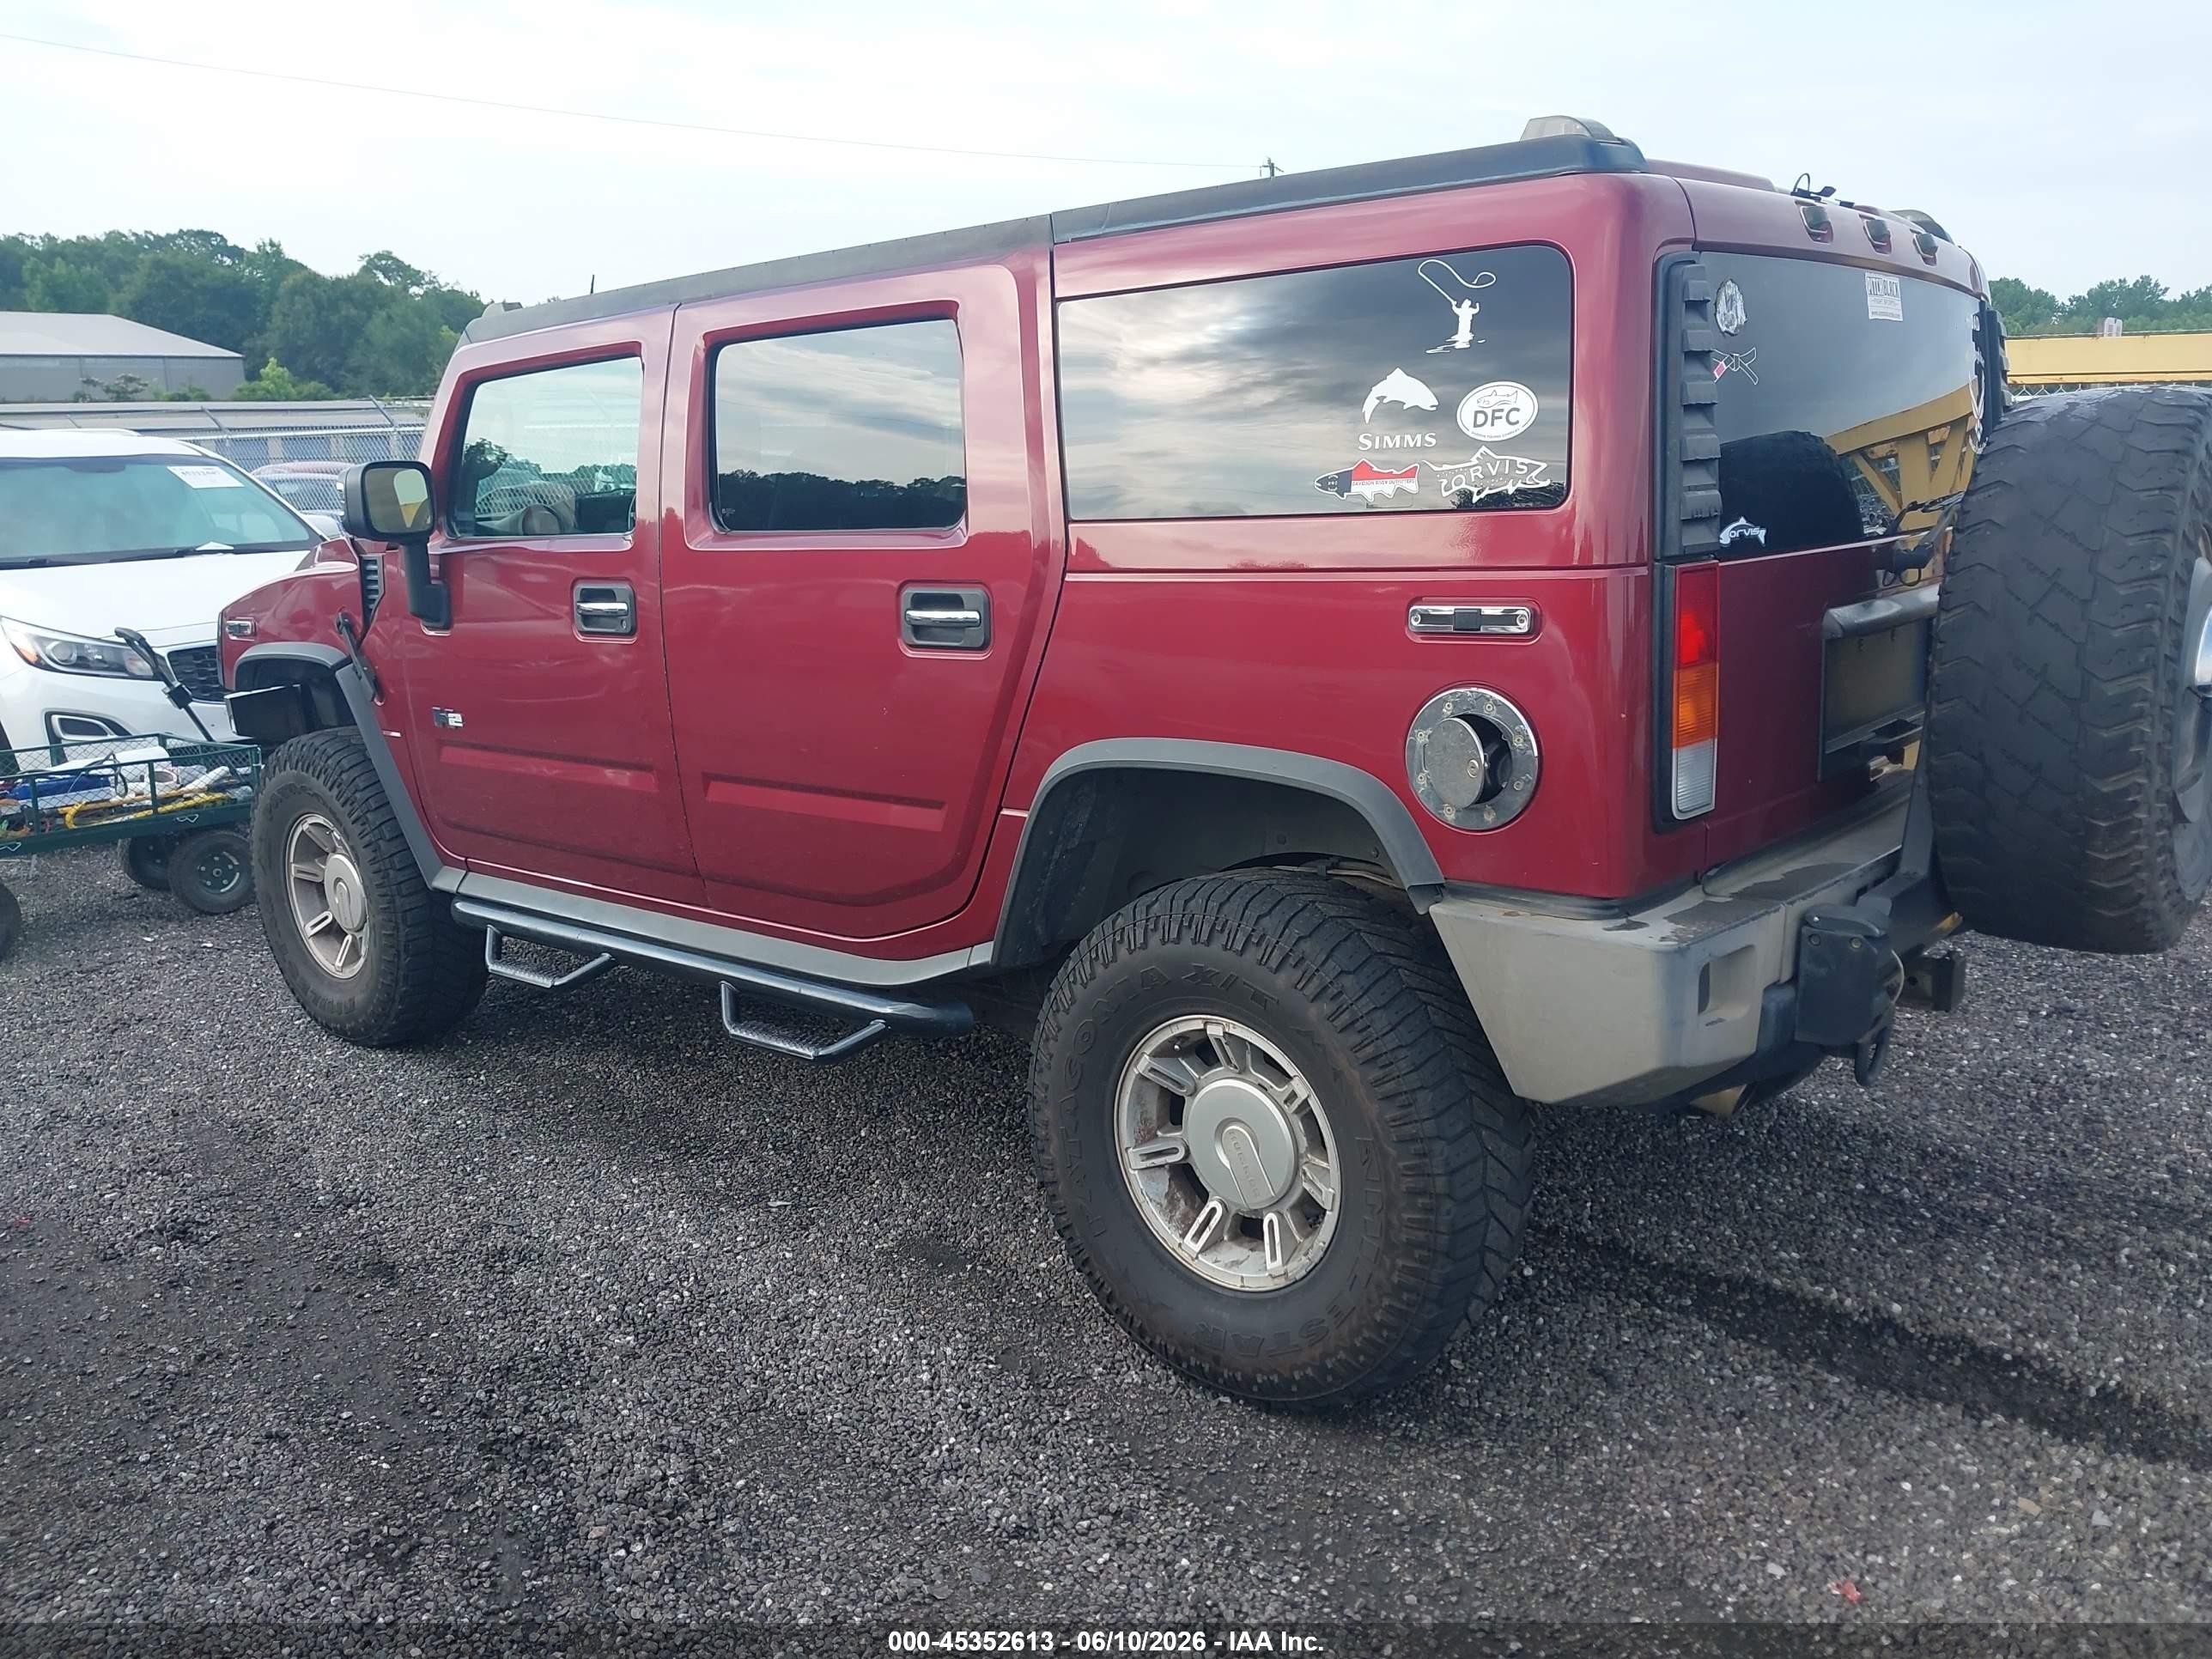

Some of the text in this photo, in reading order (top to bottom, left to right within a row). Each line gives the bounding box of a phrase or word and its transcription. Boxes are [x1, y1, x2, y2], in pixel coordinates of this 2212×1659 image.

[1474, 407, 1520, 428] DFC
[1358, 432, 1437, 451] SIMMS
[1451, 459, 1528, 489] ORVIS
